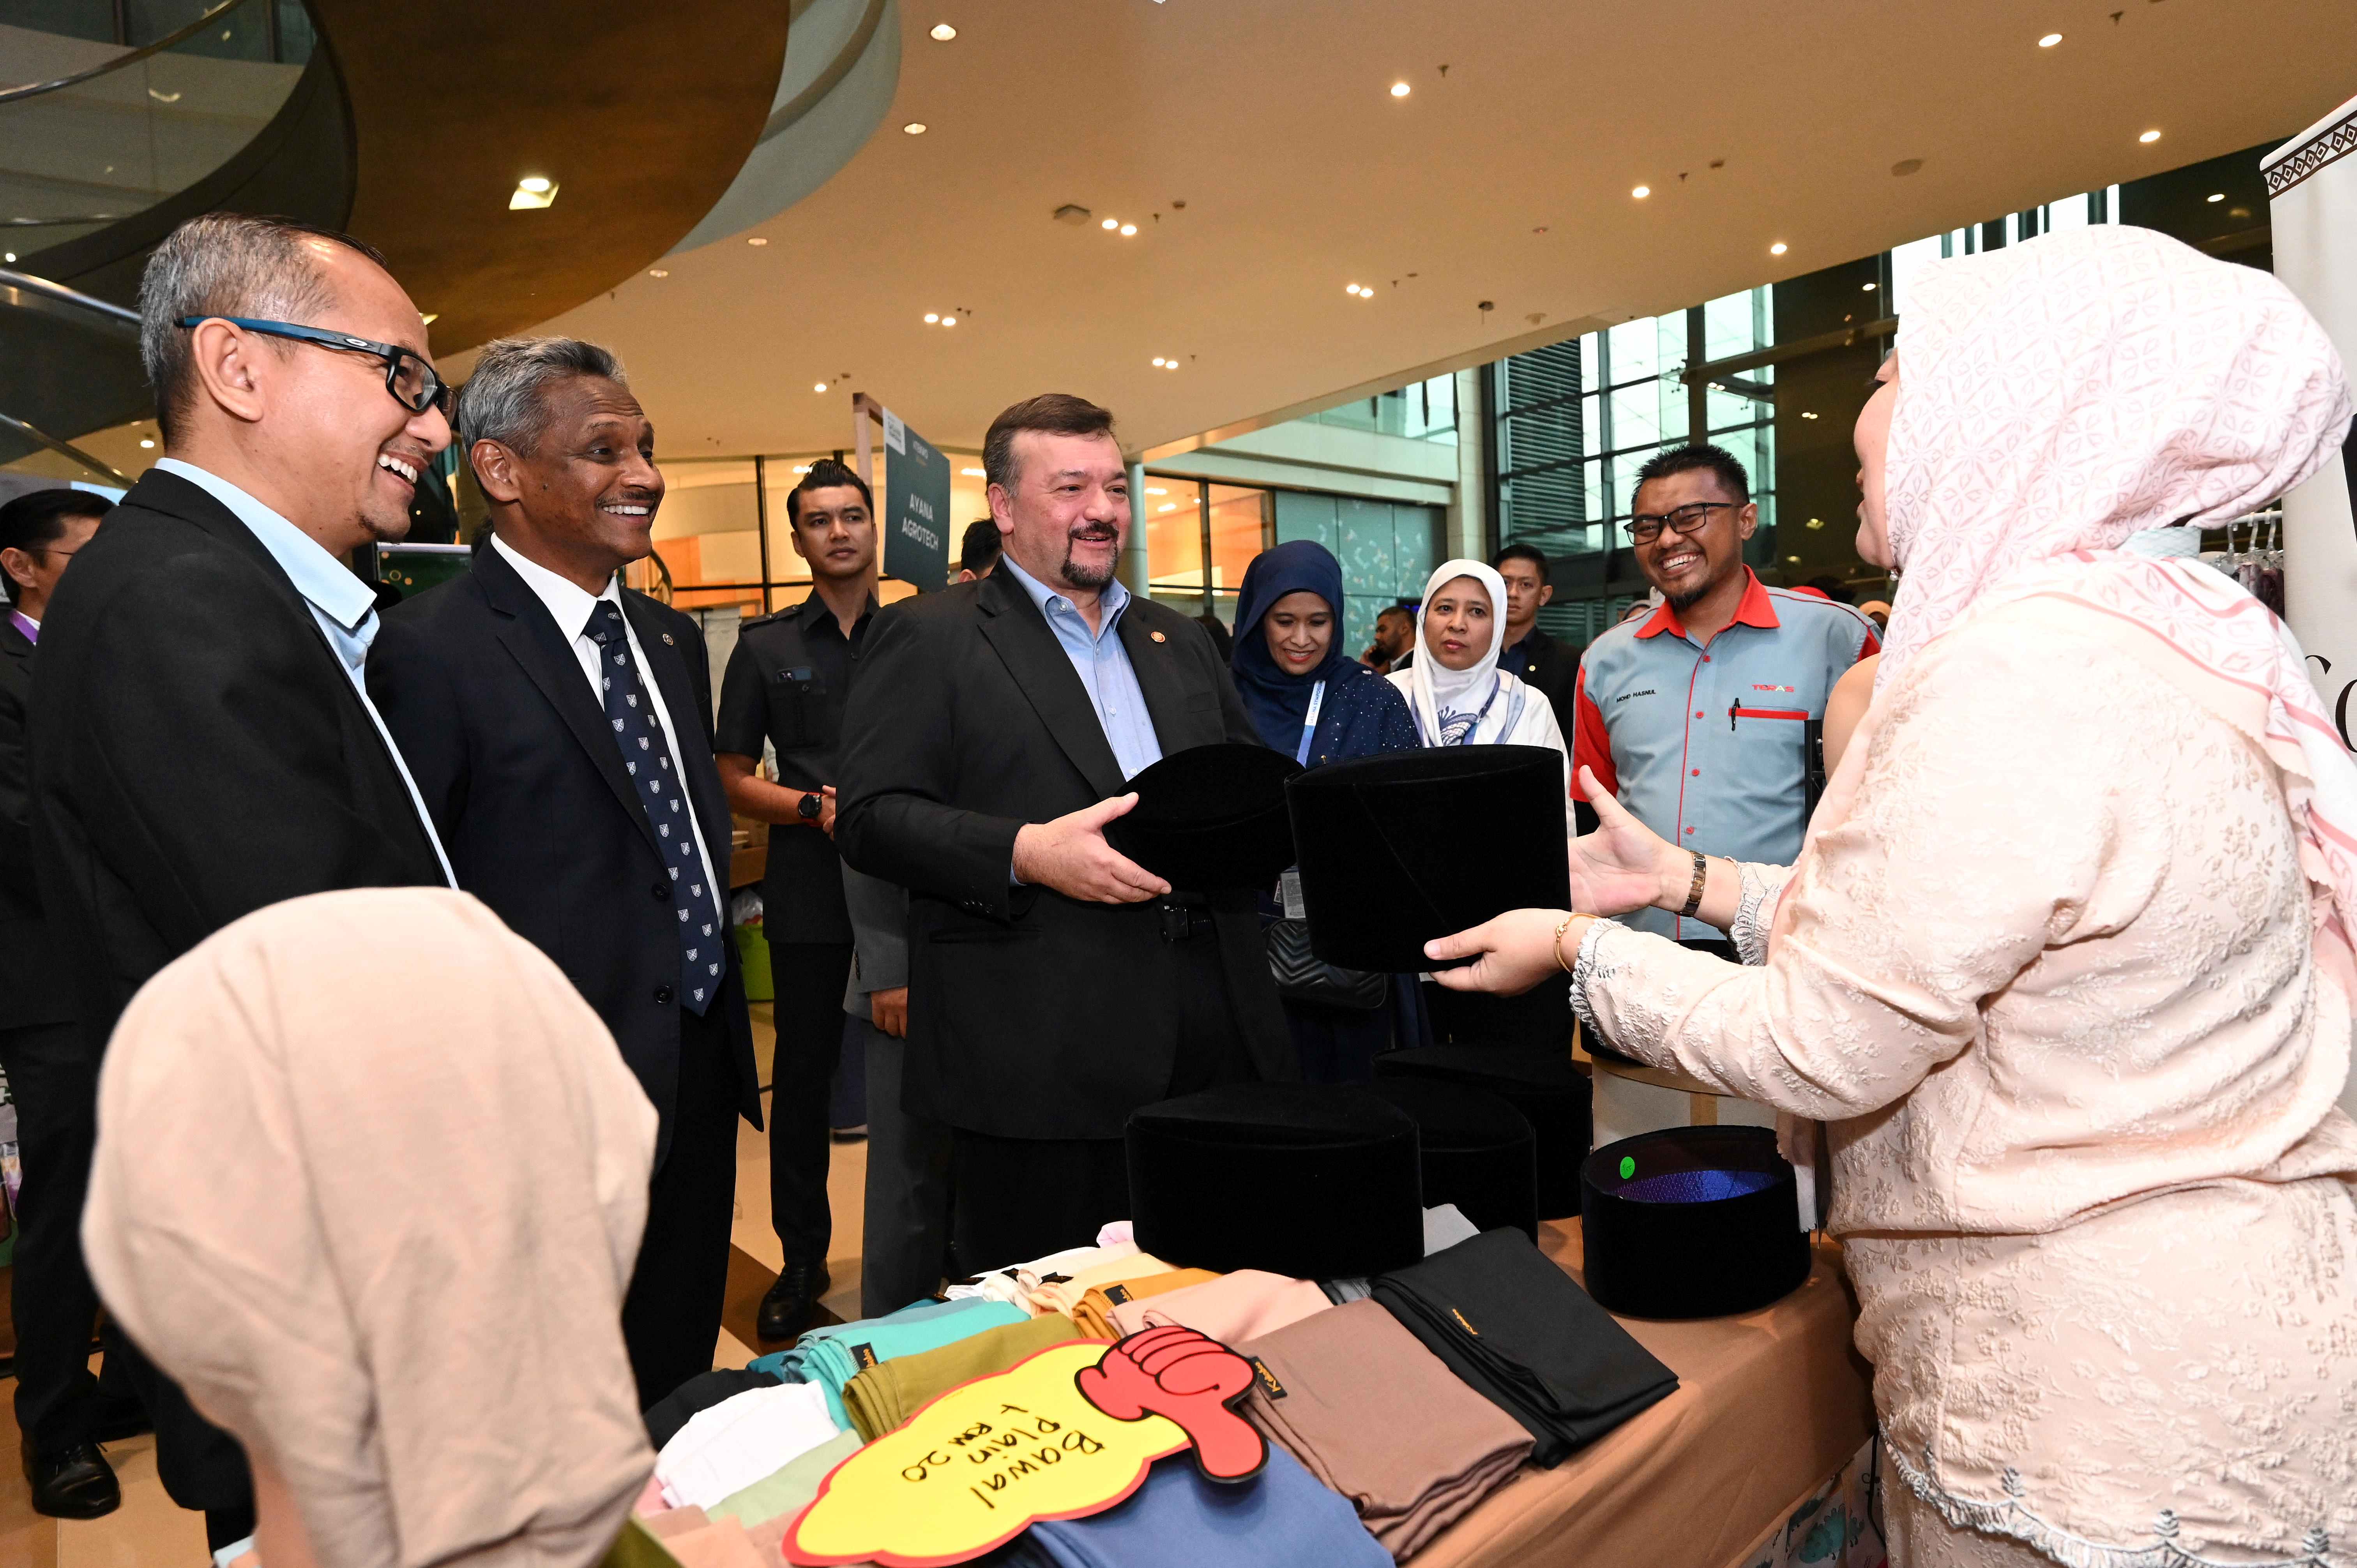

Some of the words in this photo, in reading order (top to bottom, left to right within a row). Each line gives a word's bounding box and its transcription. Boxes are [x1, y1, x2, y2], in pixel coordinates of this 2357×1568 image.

[909, 493, 933, 522] AYANA
[901, 516, 939, 551] AGROTECH
[1616, 694, 1631, 703] MOHD
[968, 1417, 1060, 1464] Plain
[902, 1450, 951, 1481] 20
[970, 1430, 1105, 1509] Bawal
